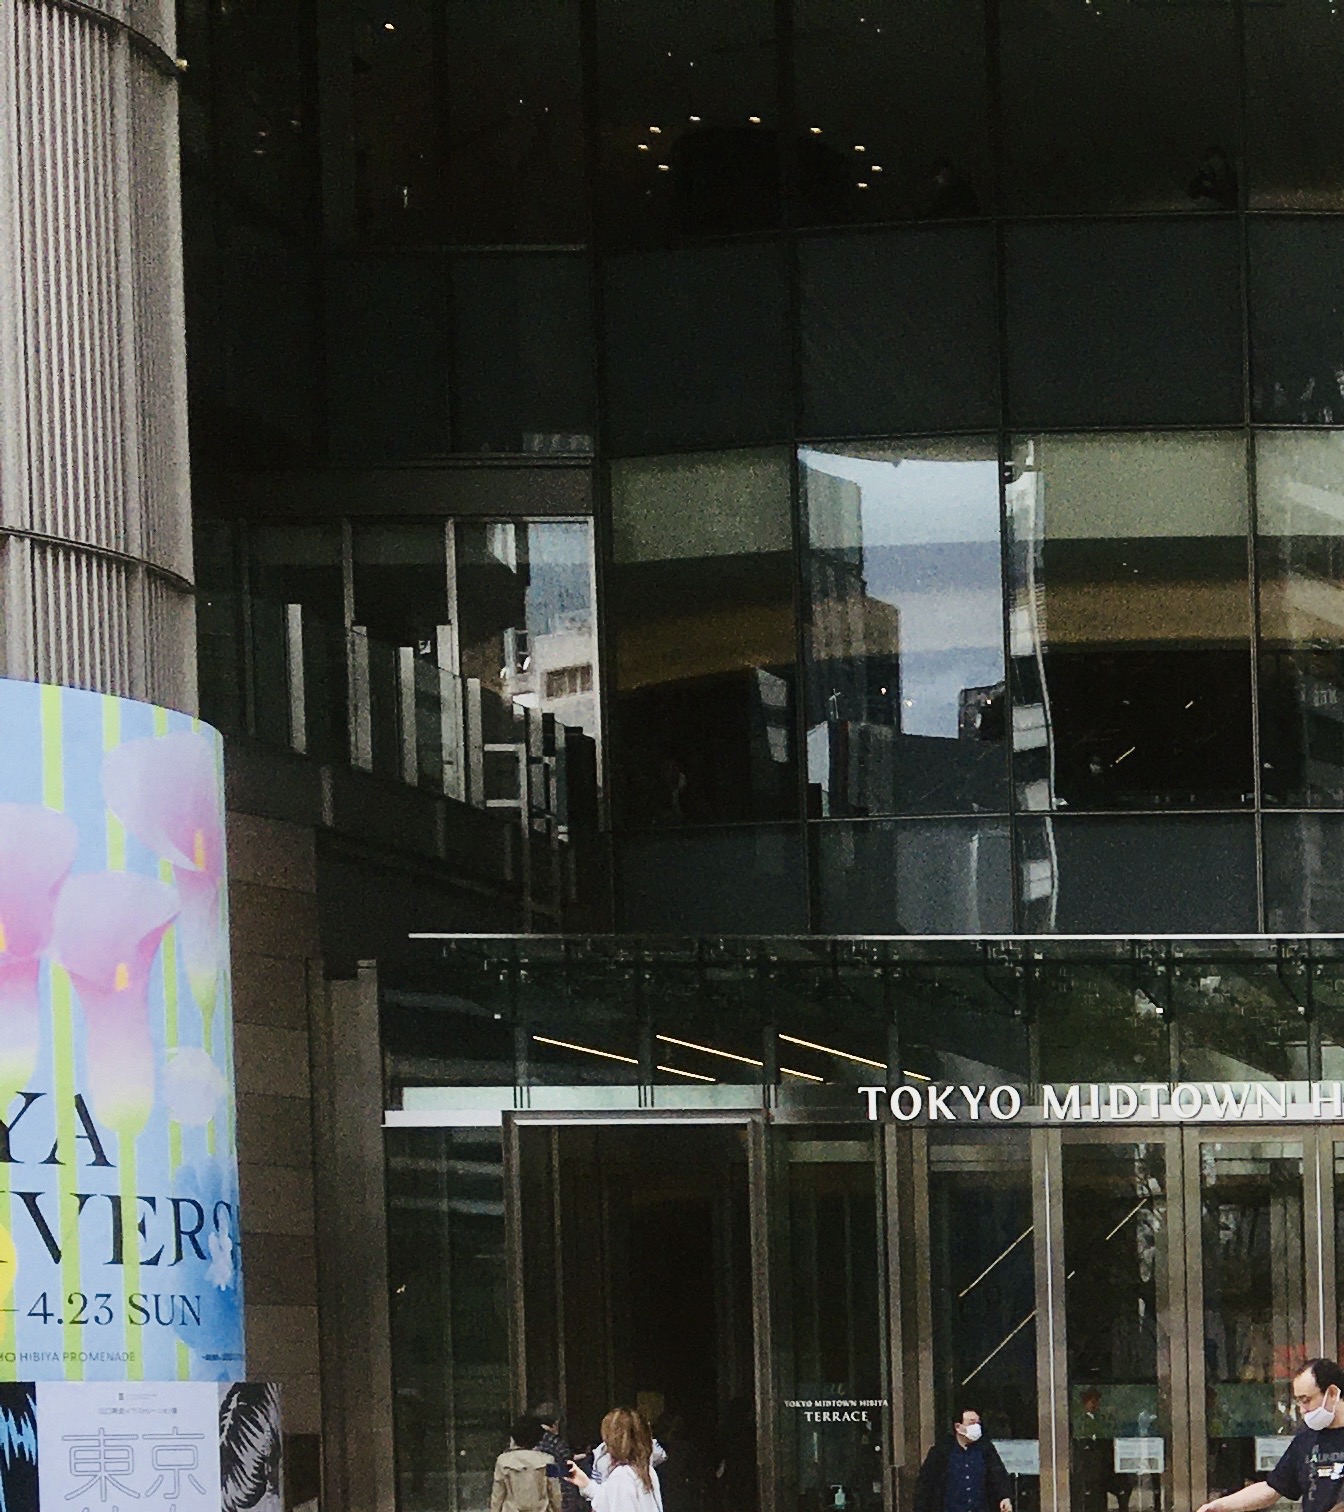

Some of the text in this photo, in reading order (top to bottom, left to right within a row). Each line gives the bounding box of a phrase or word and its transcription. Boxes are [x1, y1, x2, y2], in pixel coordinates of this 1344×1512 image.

[857, 1084, 1022, 1121] TOKYO
[1042, 1082, 1288, 1120] MIDTOWN
[128, 1293, 201, 1326] SUN
[20, 1352, 60, 1362] HIBIYA
[62, 1352, 136, 1362] PROMENADE
[784, 1400, 813, 1408] TOKYO
[804, 1411, 868, 1422] TERRACE
[62, 1427, 207, 1502] 東京
